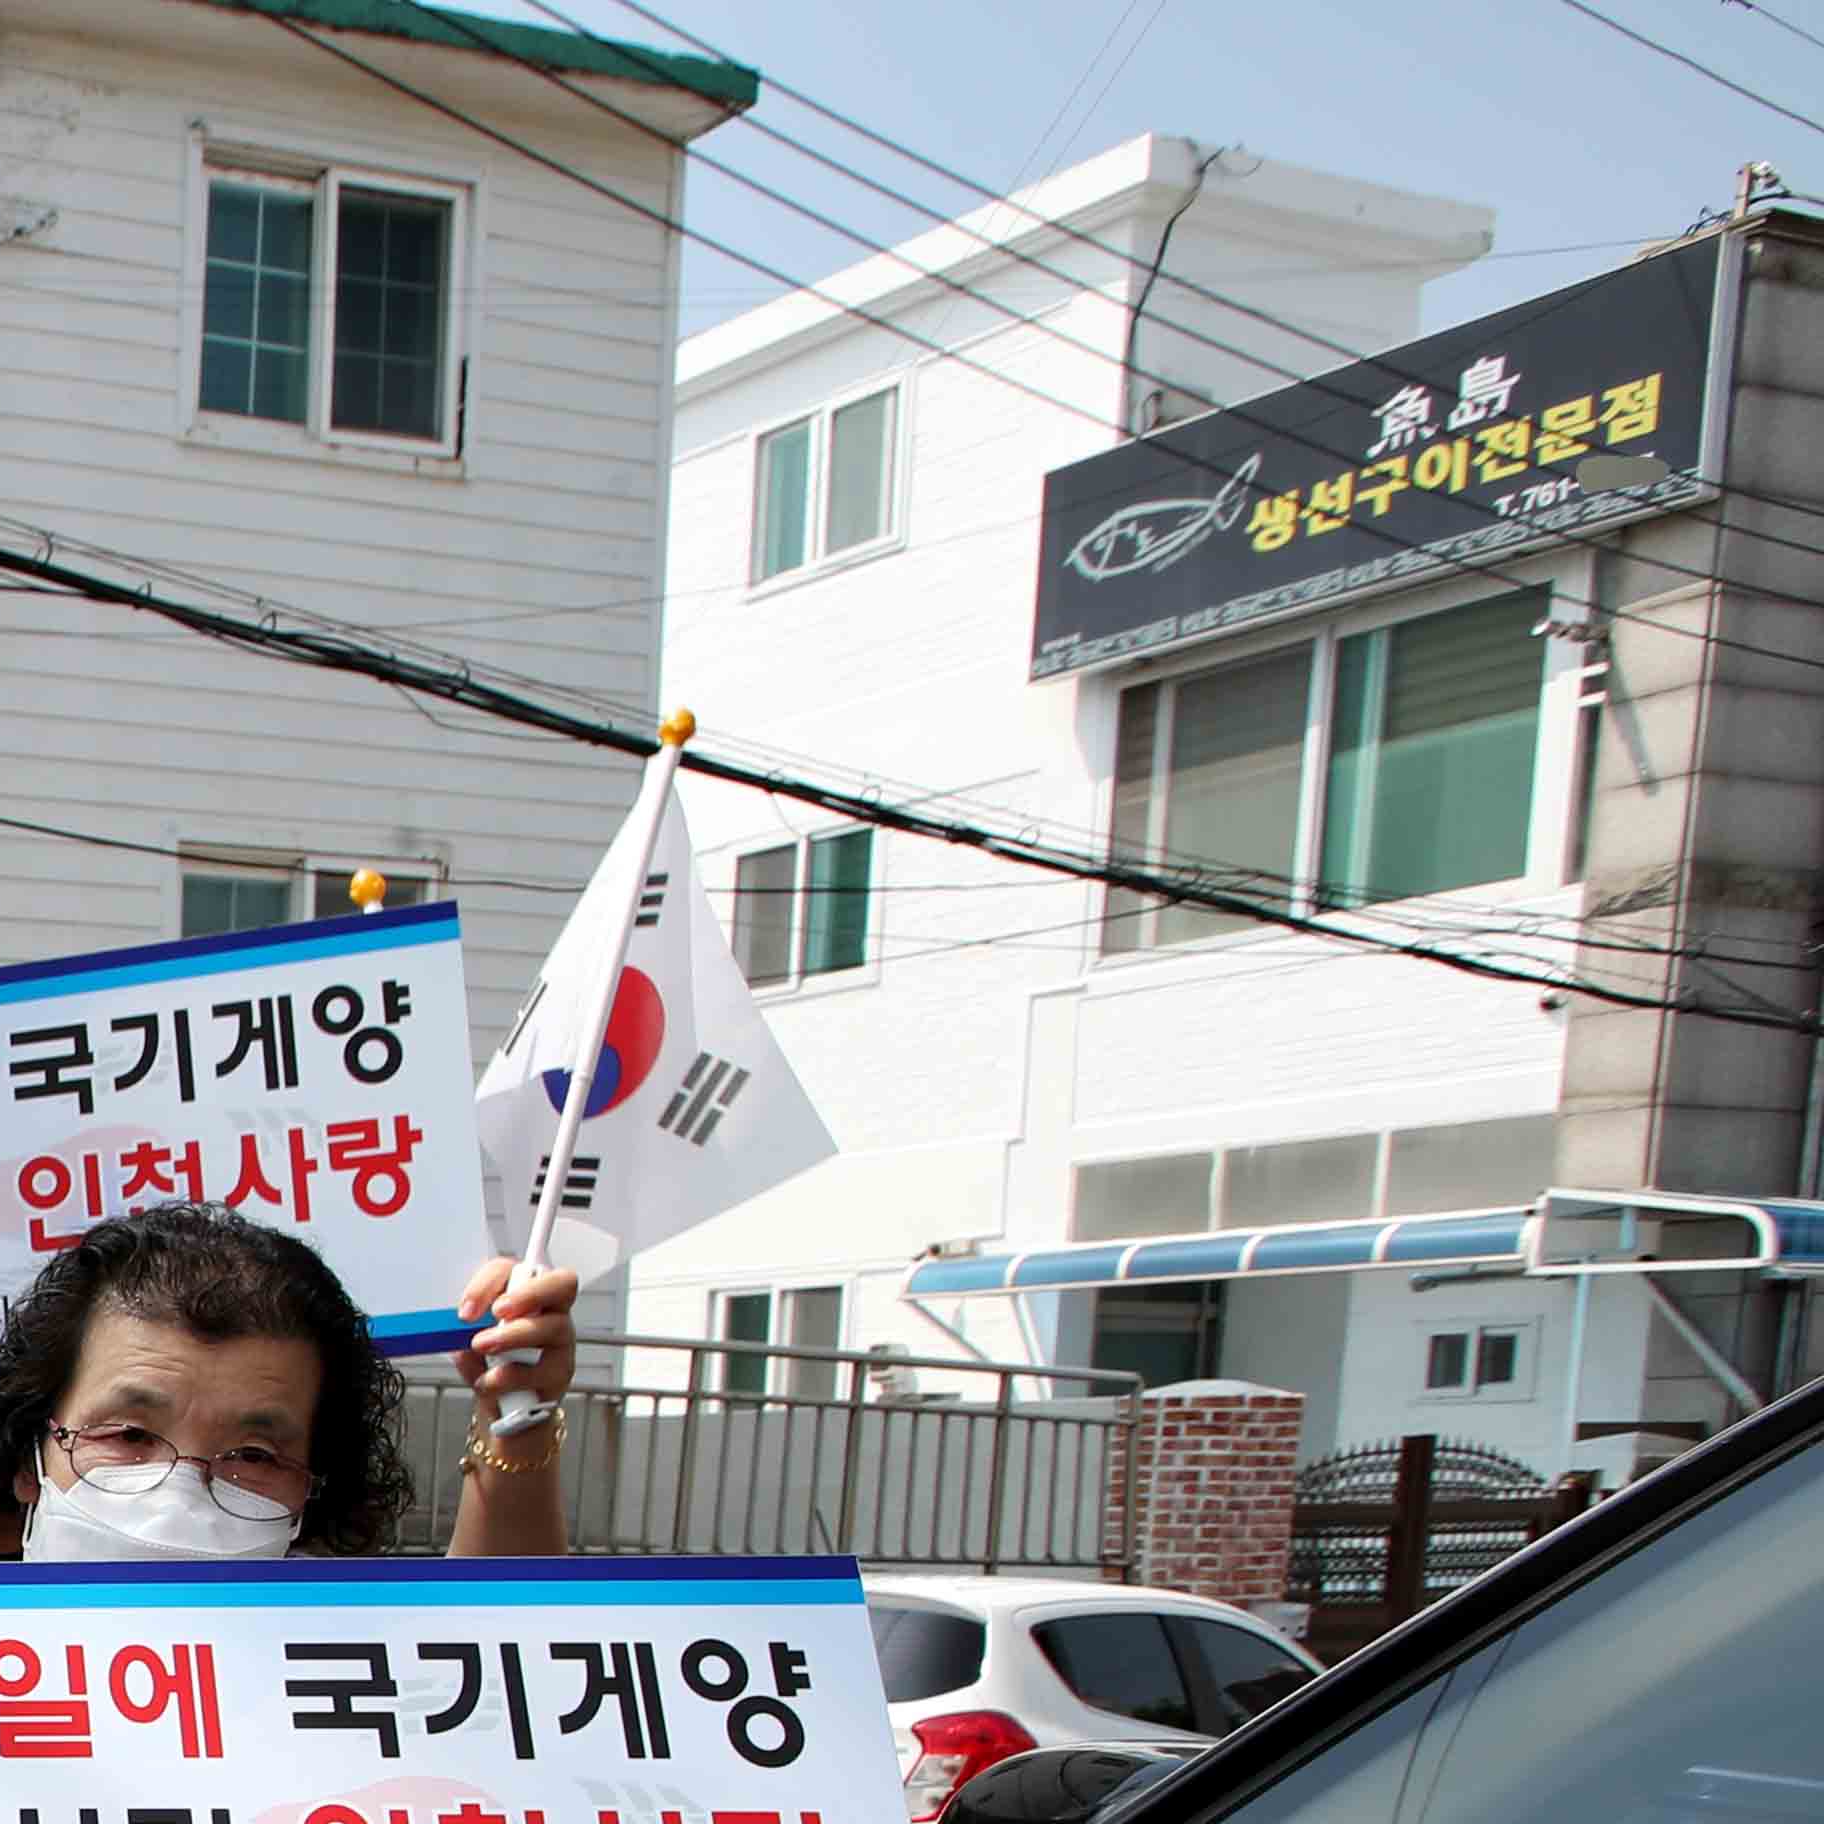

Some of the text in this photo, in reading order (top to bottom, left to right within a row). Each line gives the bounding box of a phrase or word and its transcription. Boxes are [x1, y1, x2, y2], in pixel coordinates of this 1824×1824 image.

[1245, 372, 1664, 552] 생선구이전문점
[1367, 355, 1521, 458] 魚島
[9, 979, 413, 1115] 국기게양
[18, 1115, 424, 1252] 인천사랑
[284, 1638, 811, 1768] 국기게양
